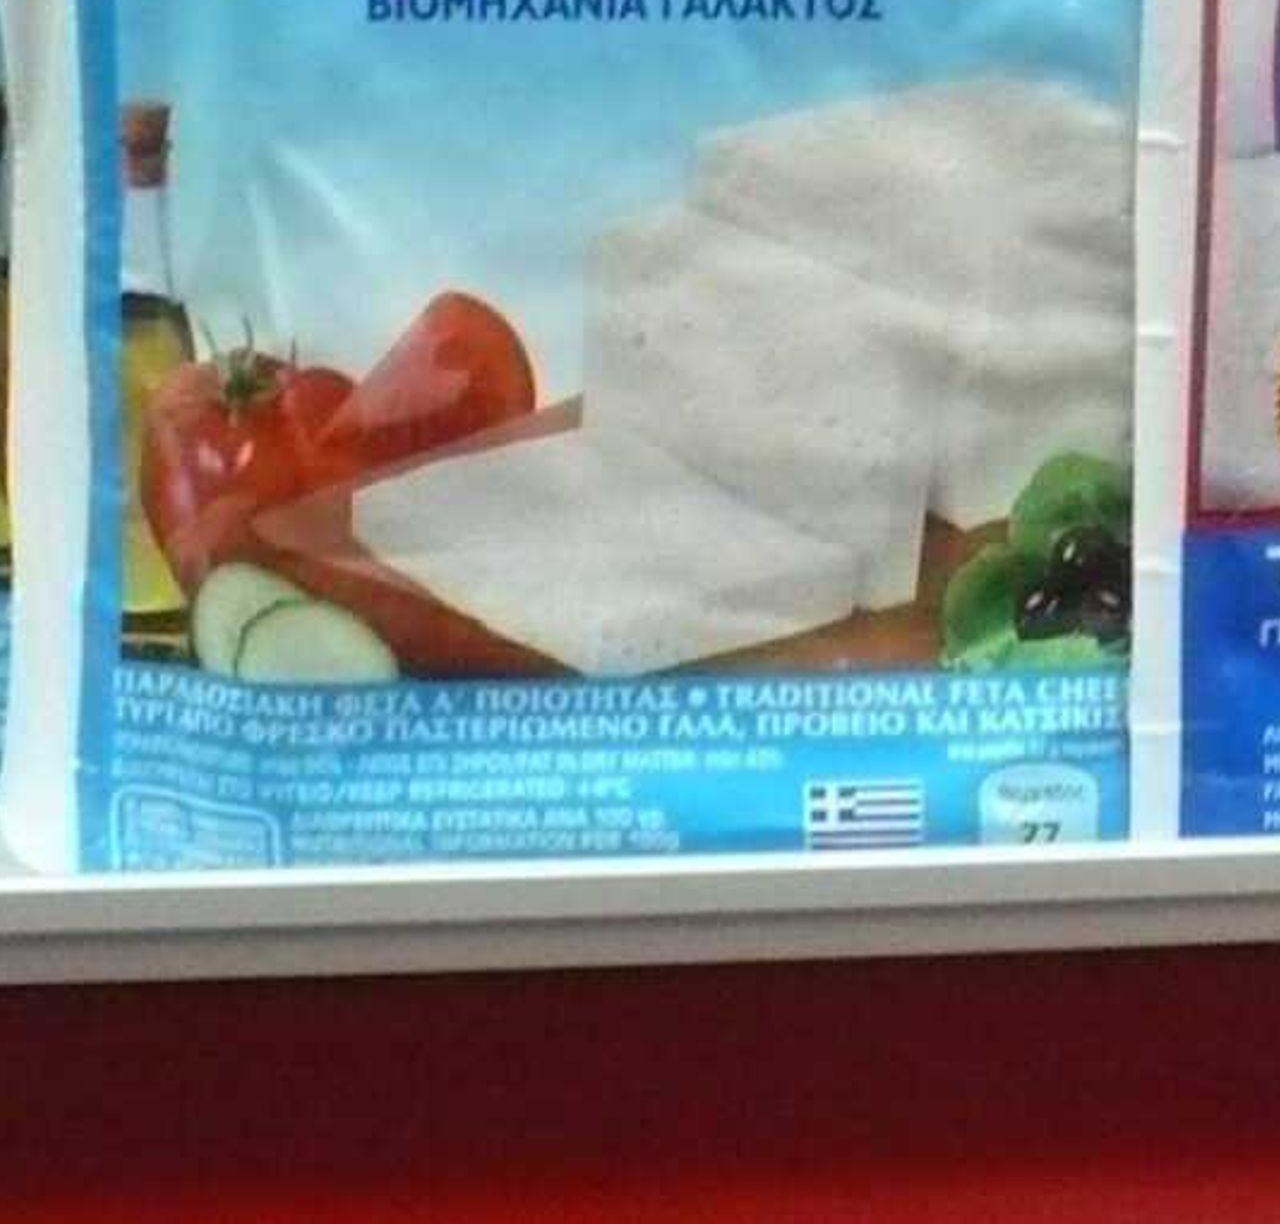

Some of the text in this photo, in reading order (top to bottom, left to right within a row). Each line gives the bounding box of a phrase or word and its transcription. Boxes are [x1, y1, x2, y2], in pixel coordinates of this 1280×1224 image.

[475, 684, 679, 714] ΠΟΙΟΤΗΤΑΣ
[719, 676, 1120, 710] TRADITIONAL FETA CHEE
[386, 713, 648, 743] ΠΑΣΤΕΡΙΩΜΕΝΟ
[757, 707, 907, 737] ΠΡΟΒΕΙΟ
[916, 707, 969, 733] ΚΑΙ
